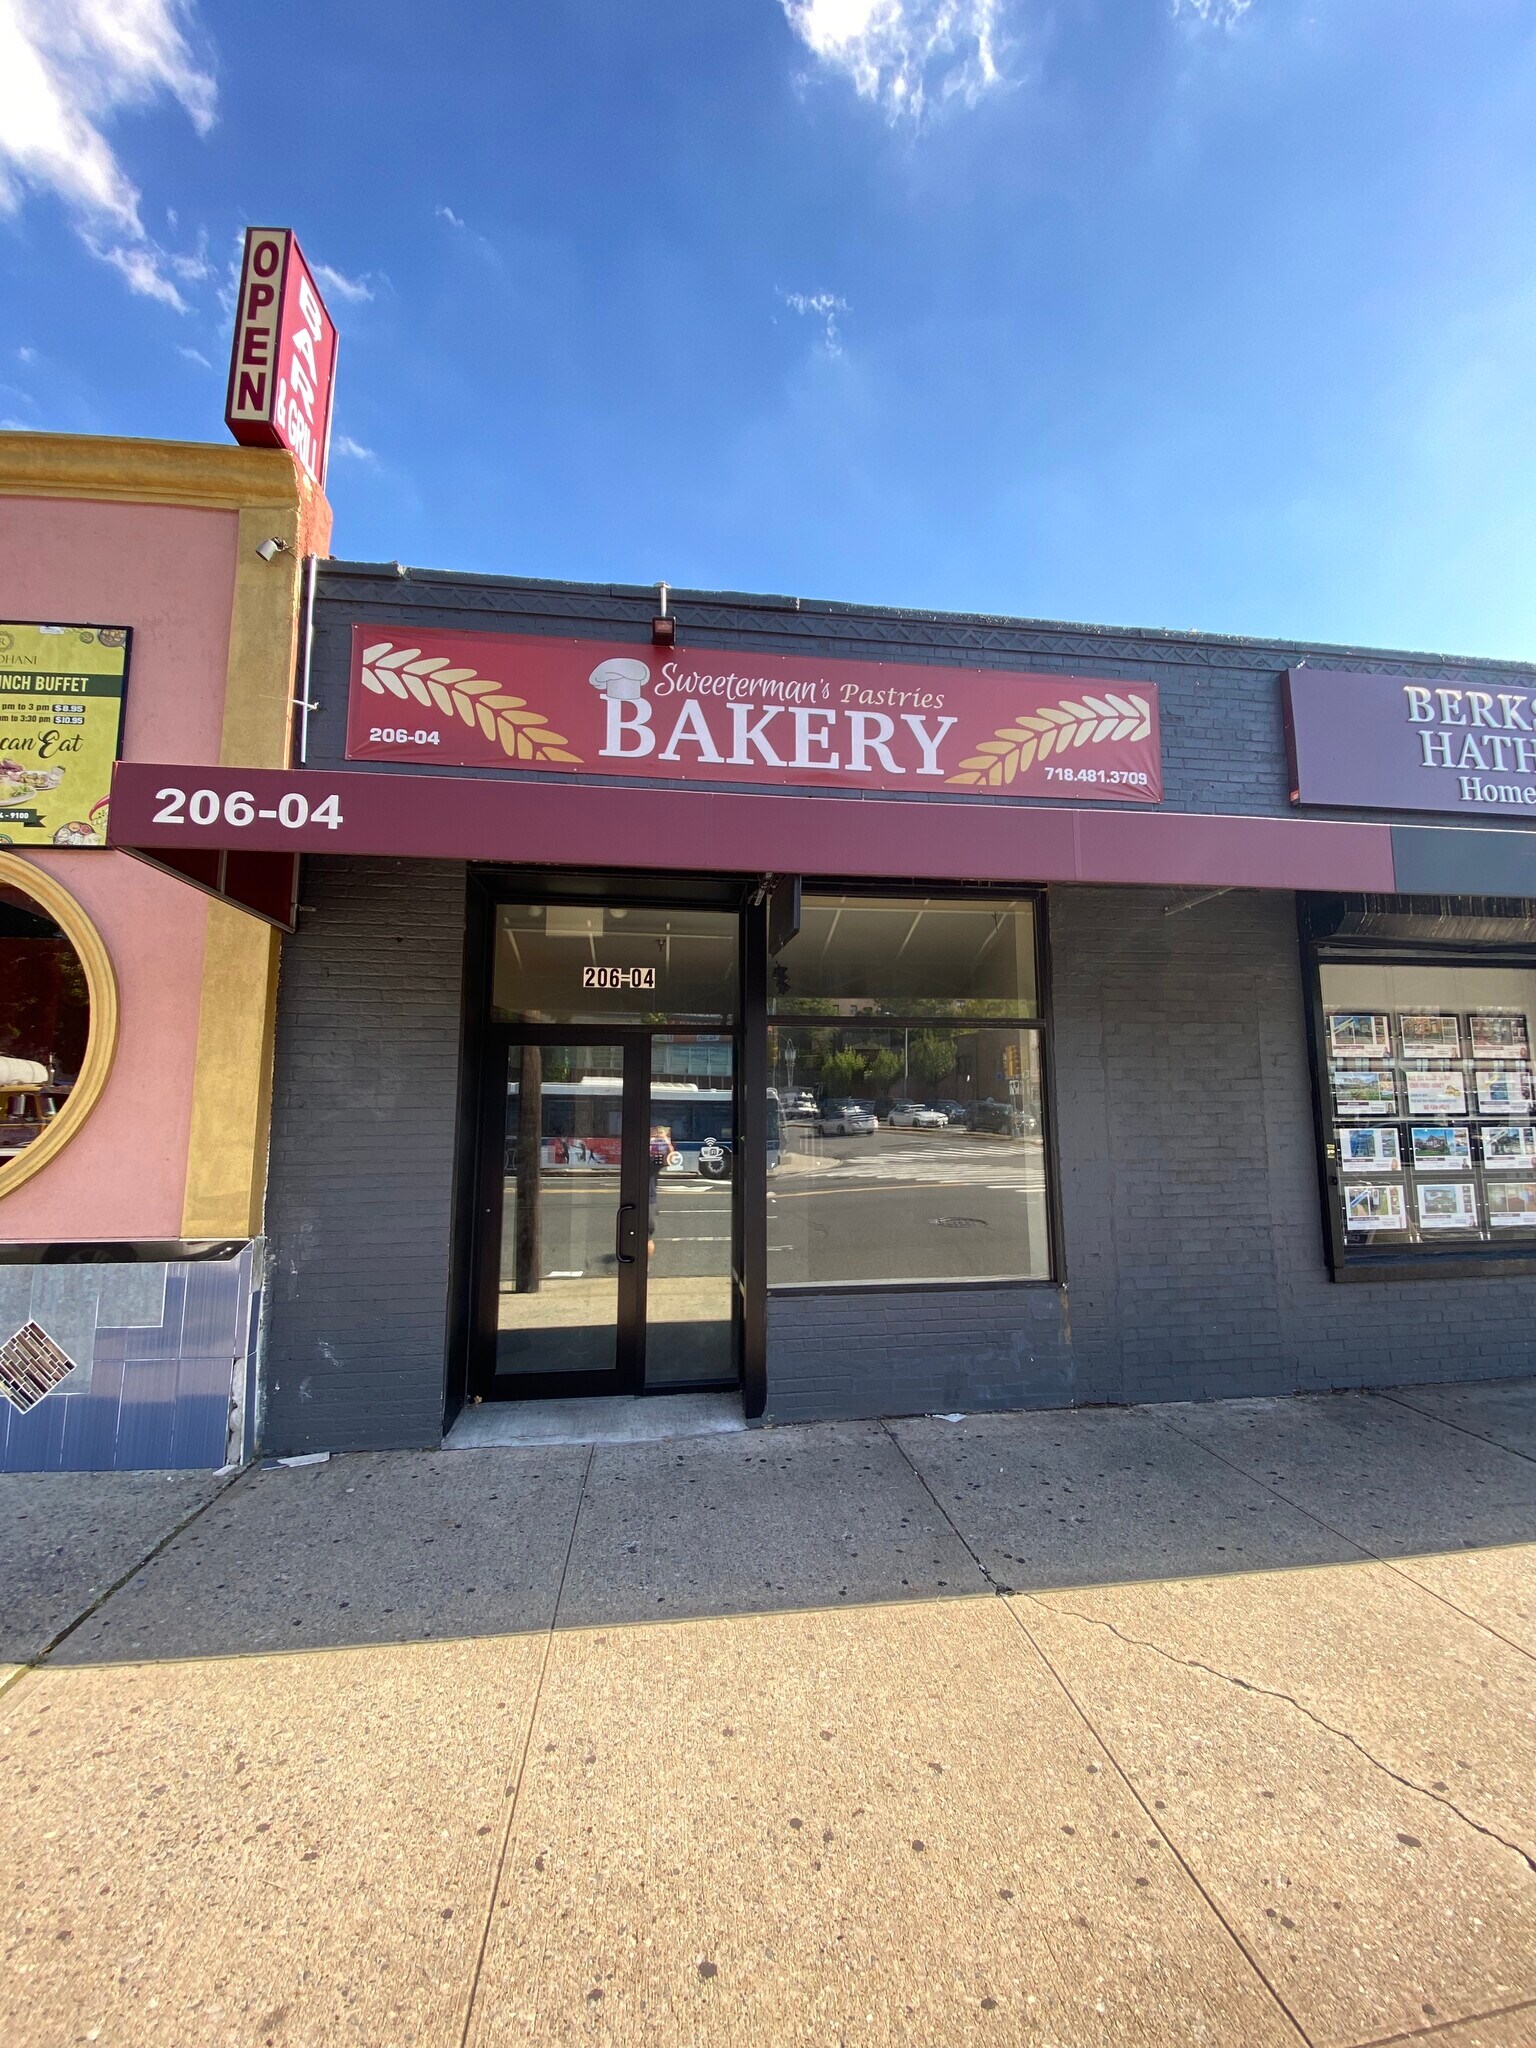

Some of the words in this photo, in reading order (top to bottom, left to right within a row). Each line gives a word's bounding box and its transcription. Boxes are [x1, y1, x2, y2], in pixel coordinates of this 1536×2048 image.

[237, 240, 280, 411] OPEN
[290, 275, 322, 425] BAR
[0, 674, 32, 691] NCH
[35, 676, 90, 693] BUFFET
[654, 661, 831, 704] Sweeterman's
[840, 682, 945, 709] Pastries
[11, 714, 18, 722] to
[20, 714, 37, 723] 3:30
[39, 716, 51, 724] pm
[55, 716, 83, 725] $10.95
[36, 704, 50, 712] pm
[54, 704, 83, 713] $8.95
[1403, 685, 1536, 731] BERK
[0, 737, 37, 751] can
[38, 729, 84, 759] Eat
[369, 727, 440, 745] 206-04
[598, 693, 958, 775] BAKERY
[1044, 767, 1148, 786] 718.481.3709
[152, 787, 344, 830] 206-04
[585, 967, 654, 988] 206-04
